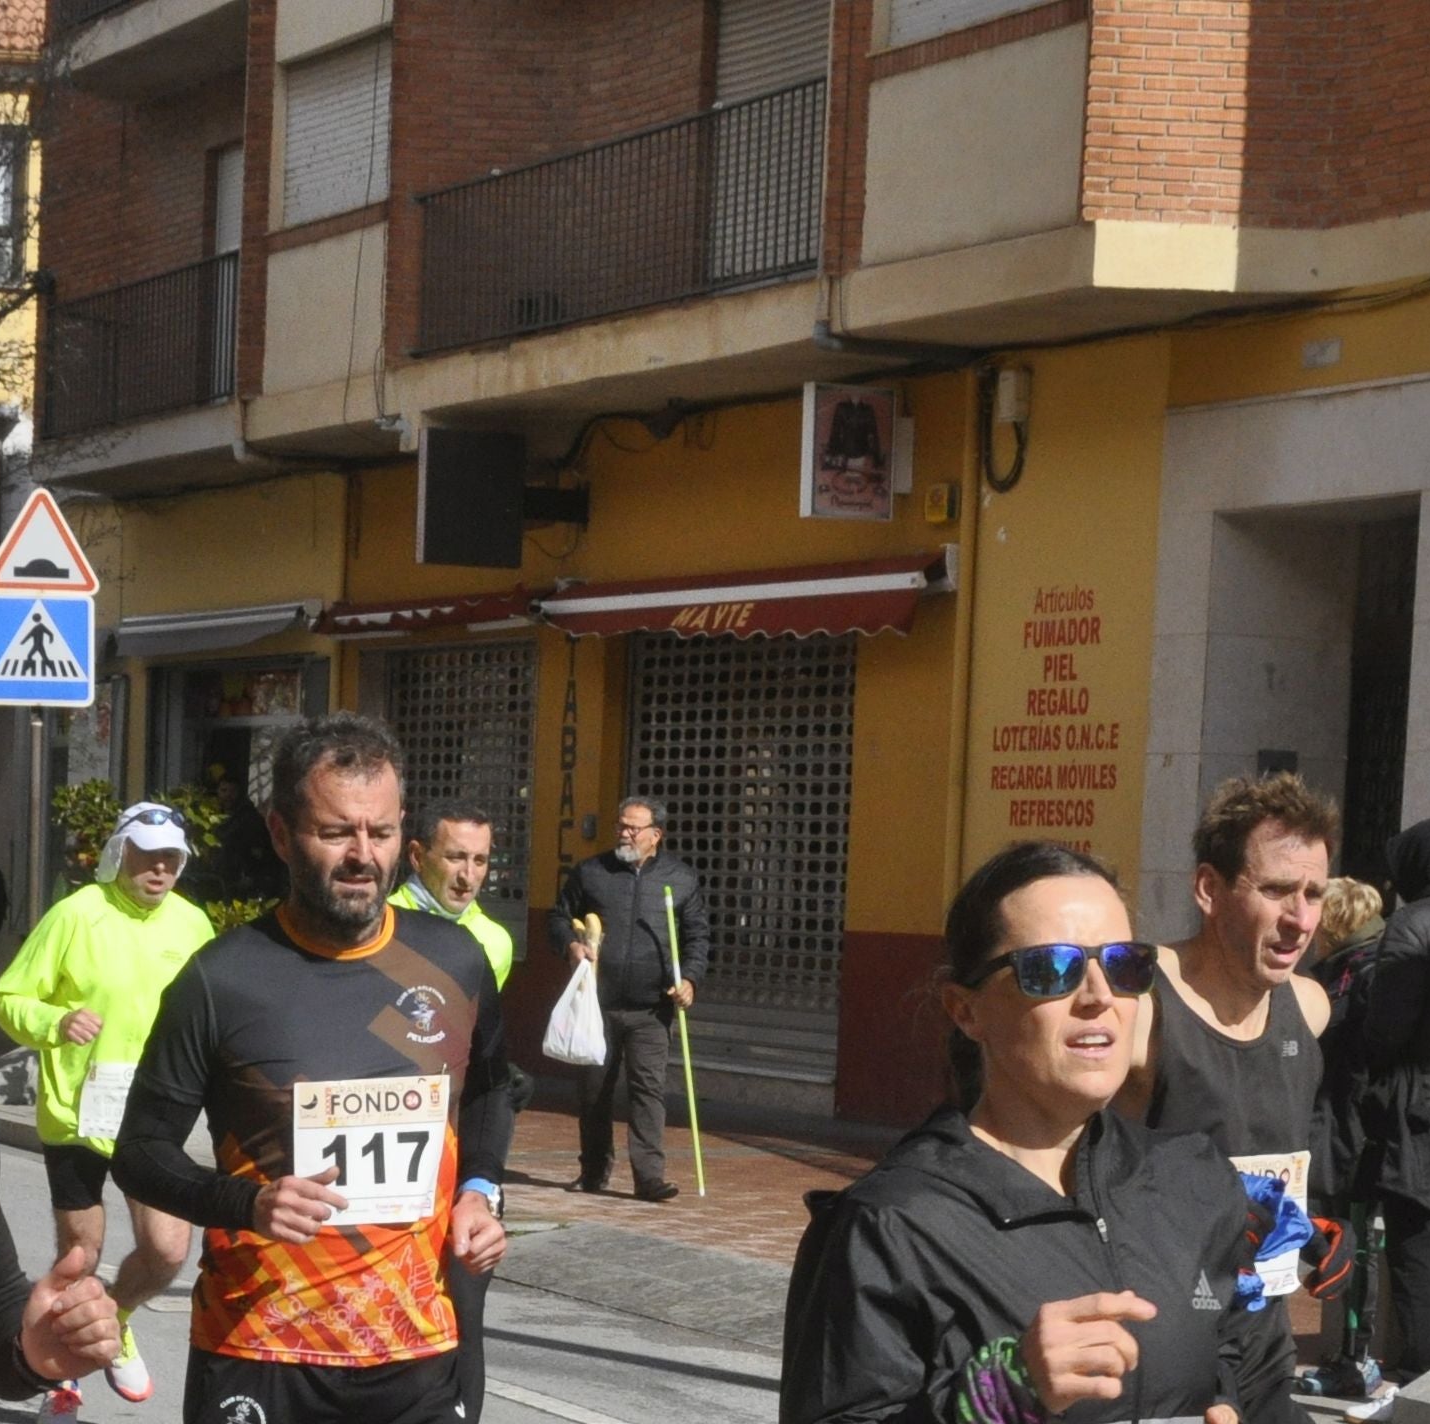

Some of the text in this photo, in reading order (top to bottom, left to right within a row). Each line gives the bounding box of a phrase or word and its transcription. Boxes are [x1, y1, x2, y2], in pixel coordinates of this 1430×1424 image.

[670, 602, 755, 629] MAYTE
[1024, 617, 1101, 648] FUMADOR
[1044, 654, 1077, 682] PIEL
[1027, 688, 1089, 716] REGALO
[991, 759, 1116, 790] RECARGA MÓVILES
[1009, 799, 1095, 827] REFRESCOS
[330, 1090, 422, 1115] FONDO
[322, 1131, 430, 1187] 117
